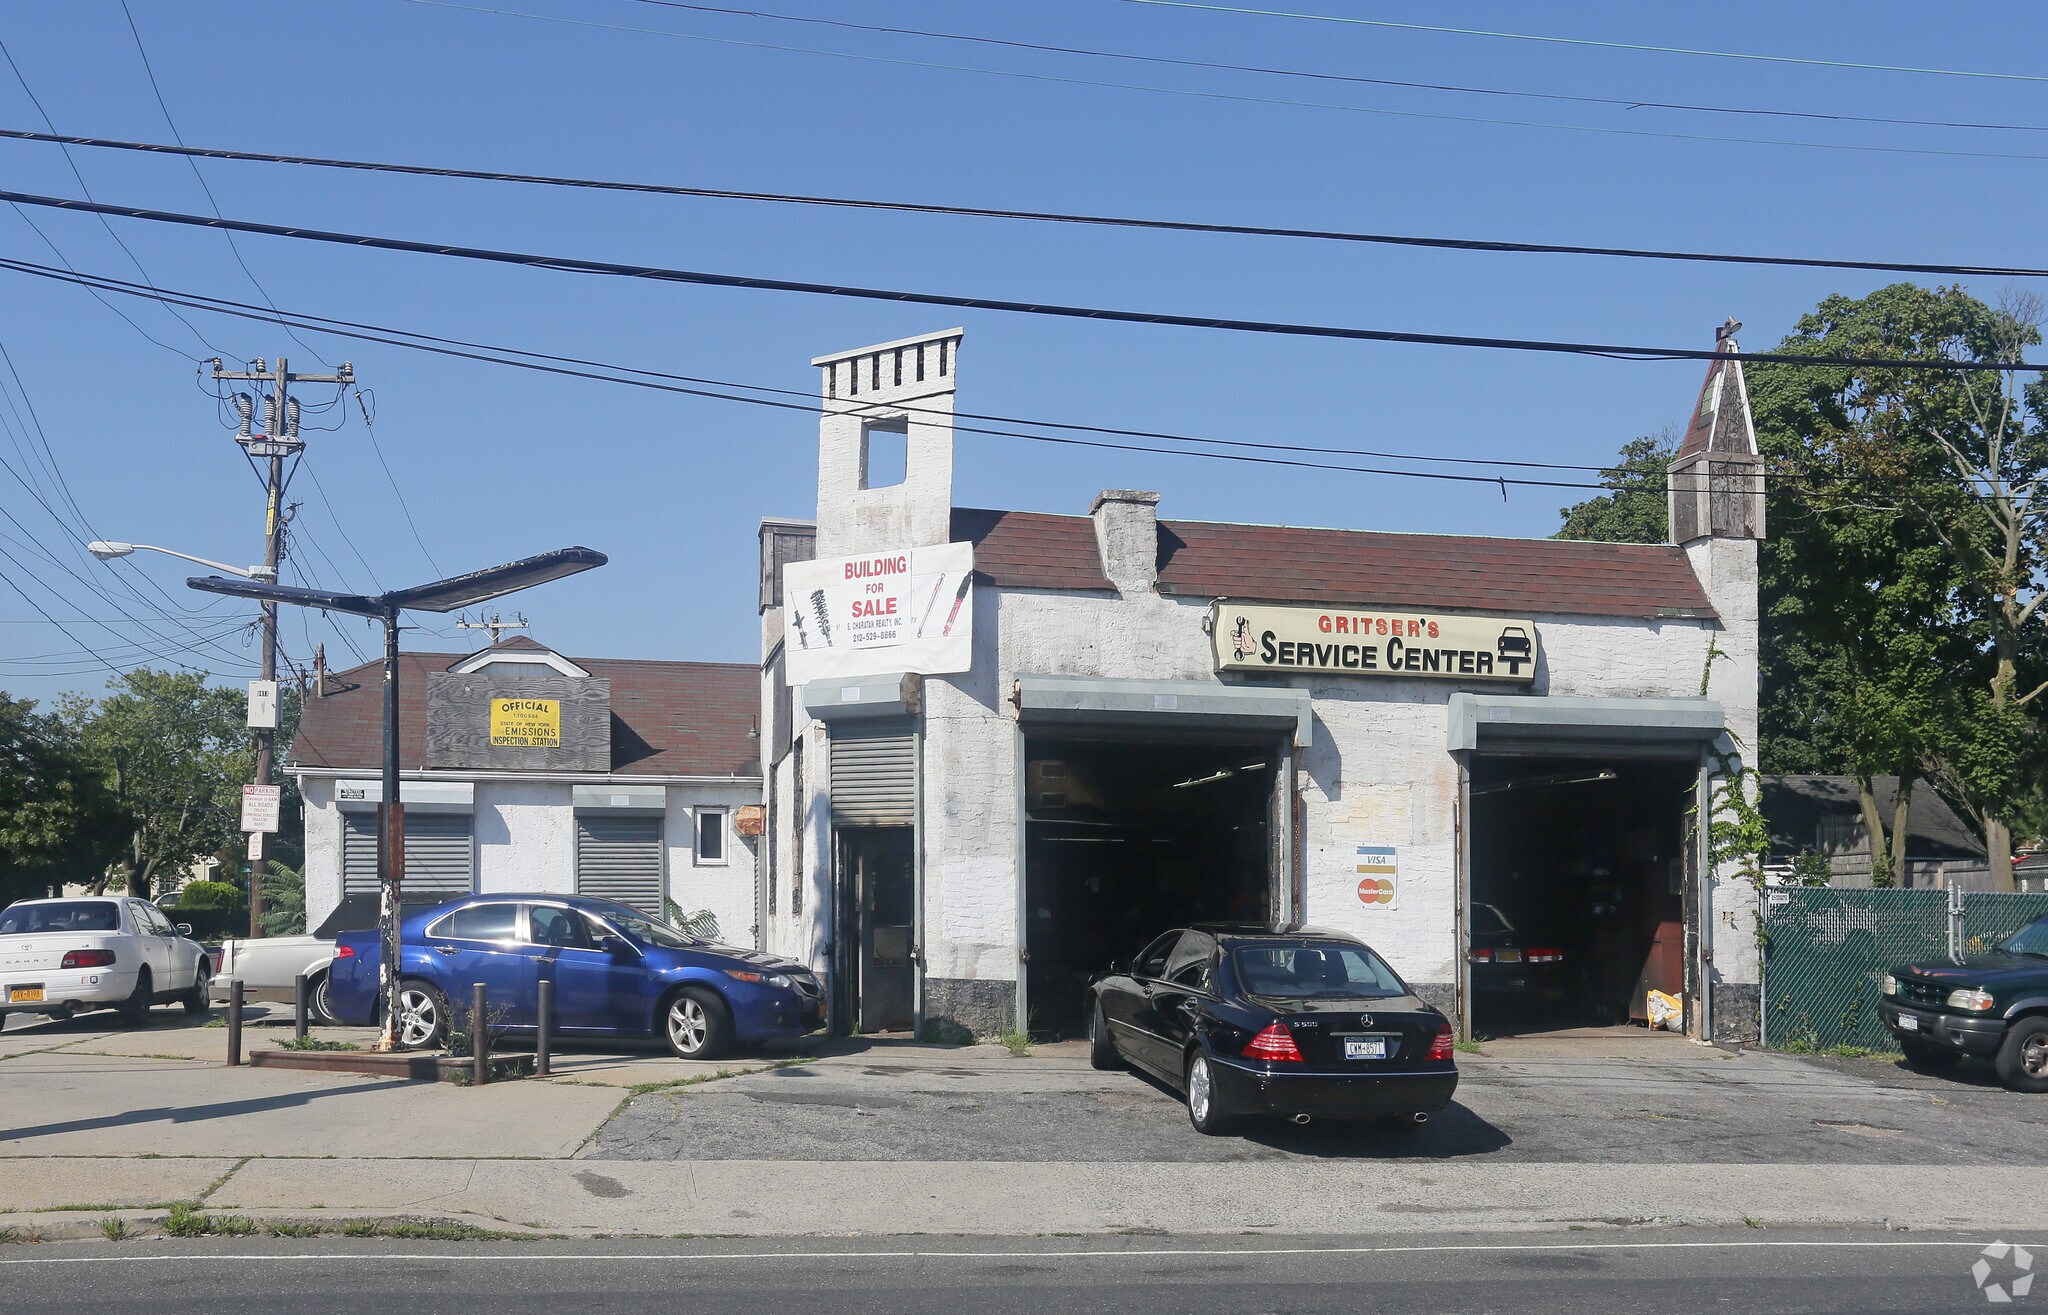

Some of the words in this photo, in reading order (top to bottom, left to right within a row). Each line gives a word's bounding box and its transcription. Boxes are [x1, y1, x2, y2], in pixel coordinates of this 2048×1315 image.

[844, 556, 907, 580] BUILDING
[865, 582, 884, 594] FOR
[851, 597, 898, 618] SALE
[852, 620, 876, 630] CHARATAN
[1318, 615, 1440, 639] GRITSER'S
[853, 630, 897, 642] 212-529-8866
[1260, 630, 1378, 669] SERVICE
[1386, 637, 1494, 675] CENTER
[501, 701, 549, 713] OFFICIAL
[505, 727, 556, 737] EMISSIONS
[492, 736, 529, 745] INSPECTION
[532, 737, 558, 746] STATION
[244, 786, 254, 794] NO
[1367, 856, 1386, 864] VISA
